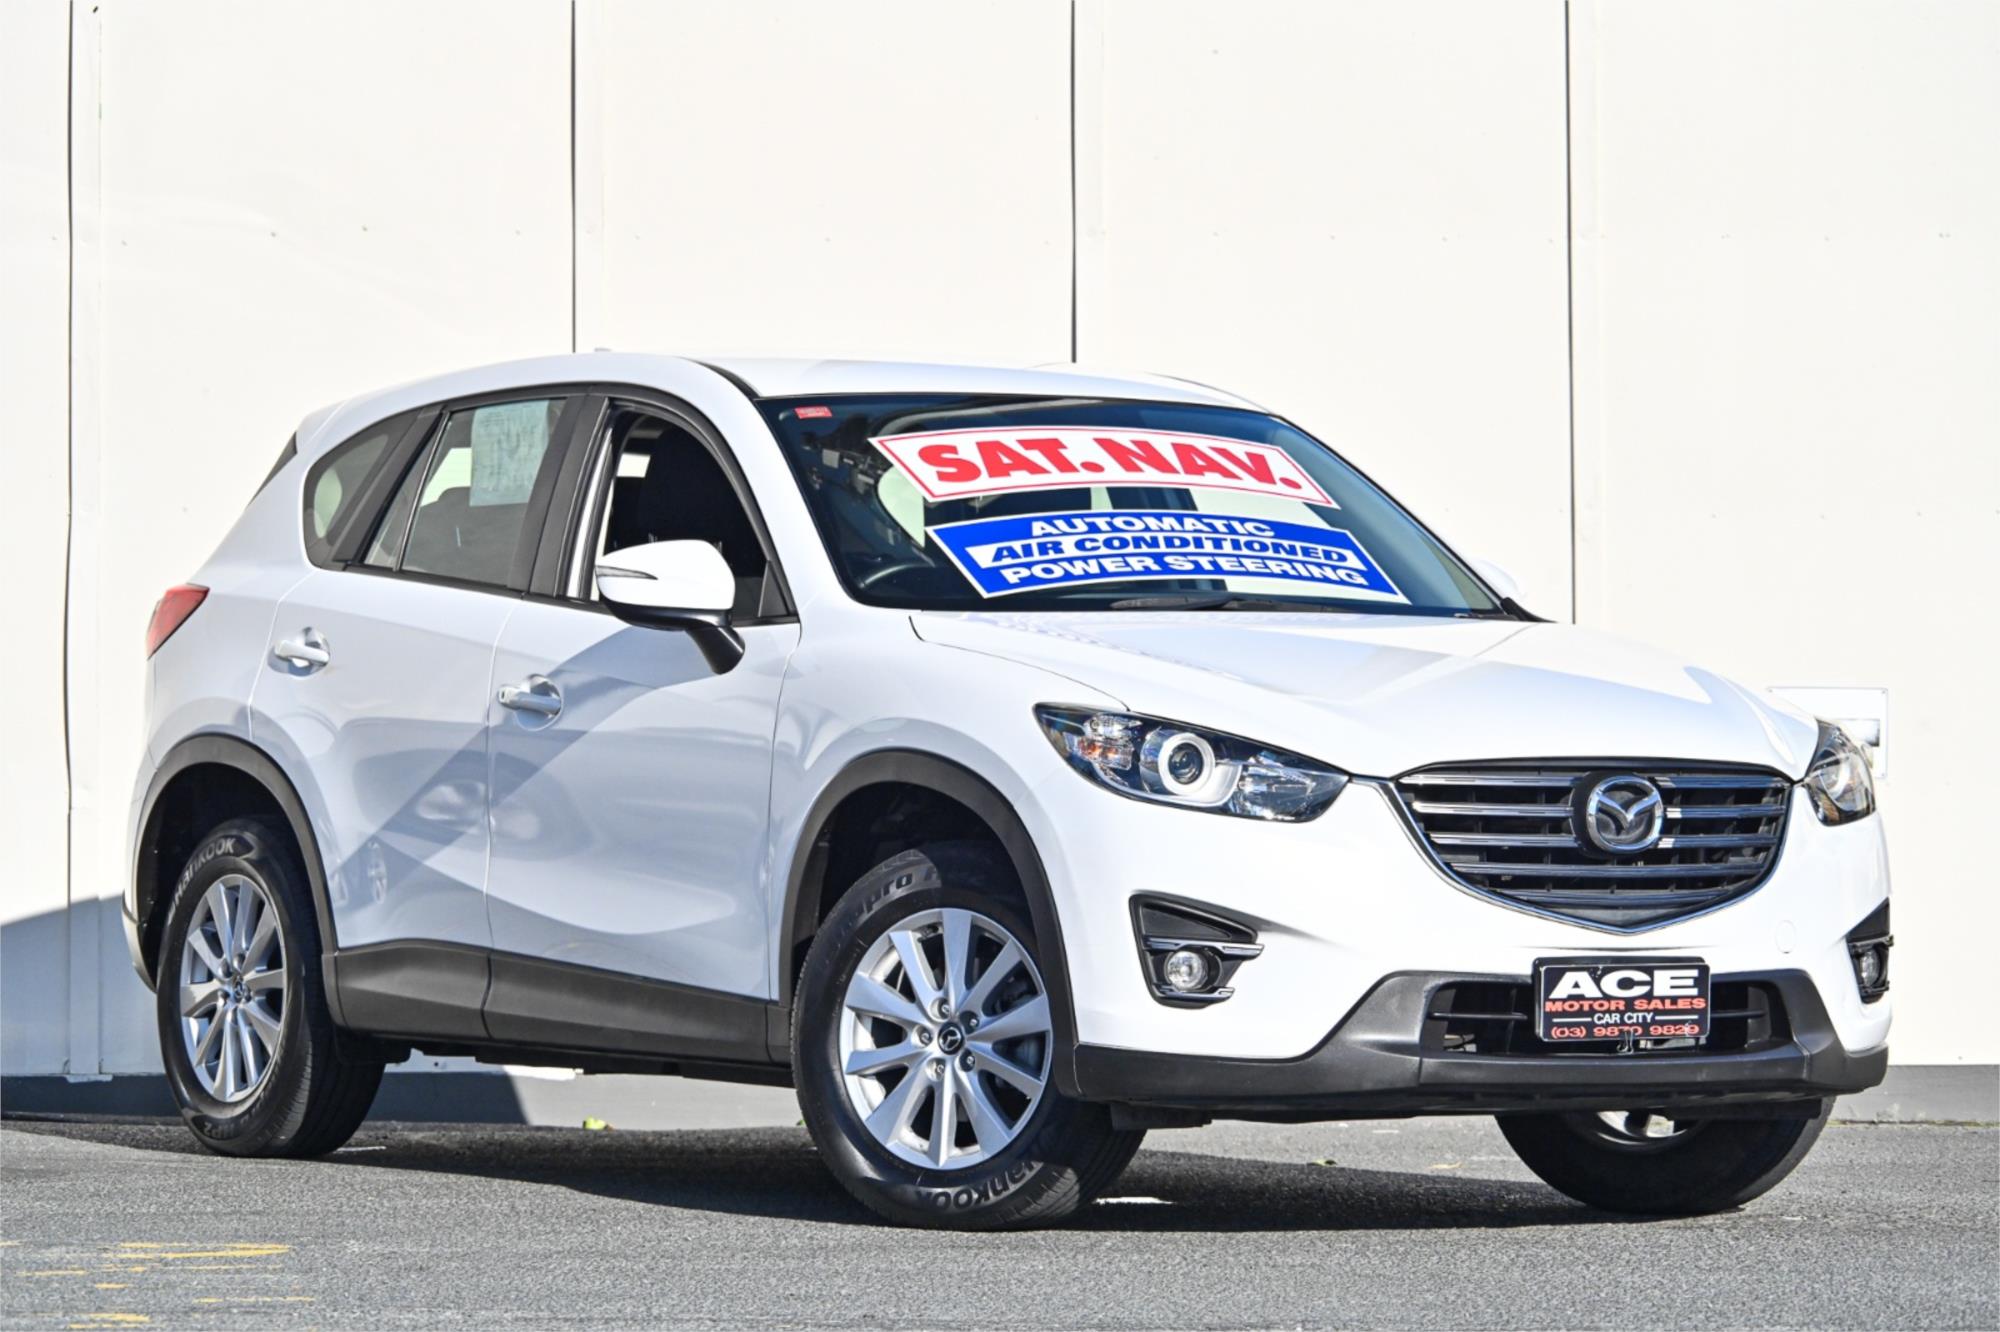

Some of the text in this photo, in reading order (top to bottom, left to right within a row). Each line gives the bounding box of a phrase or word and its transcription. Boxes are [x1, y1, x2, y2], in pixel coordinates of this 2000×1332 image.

[1031, 516, 1275, 538] AUTOMATIC
[991, 536, 1348, 563] AIR CONDITIONED
[1000, 555, 1370, 586] POWER STEERING
[1548, 969, 1699, 999] ACE
[1545, 998, 1706, 1012] MOTOR SALES
[1593, 1012, 1654, 1024] CAR CITY
[1551, 1026, 1587, 1039] (03)
